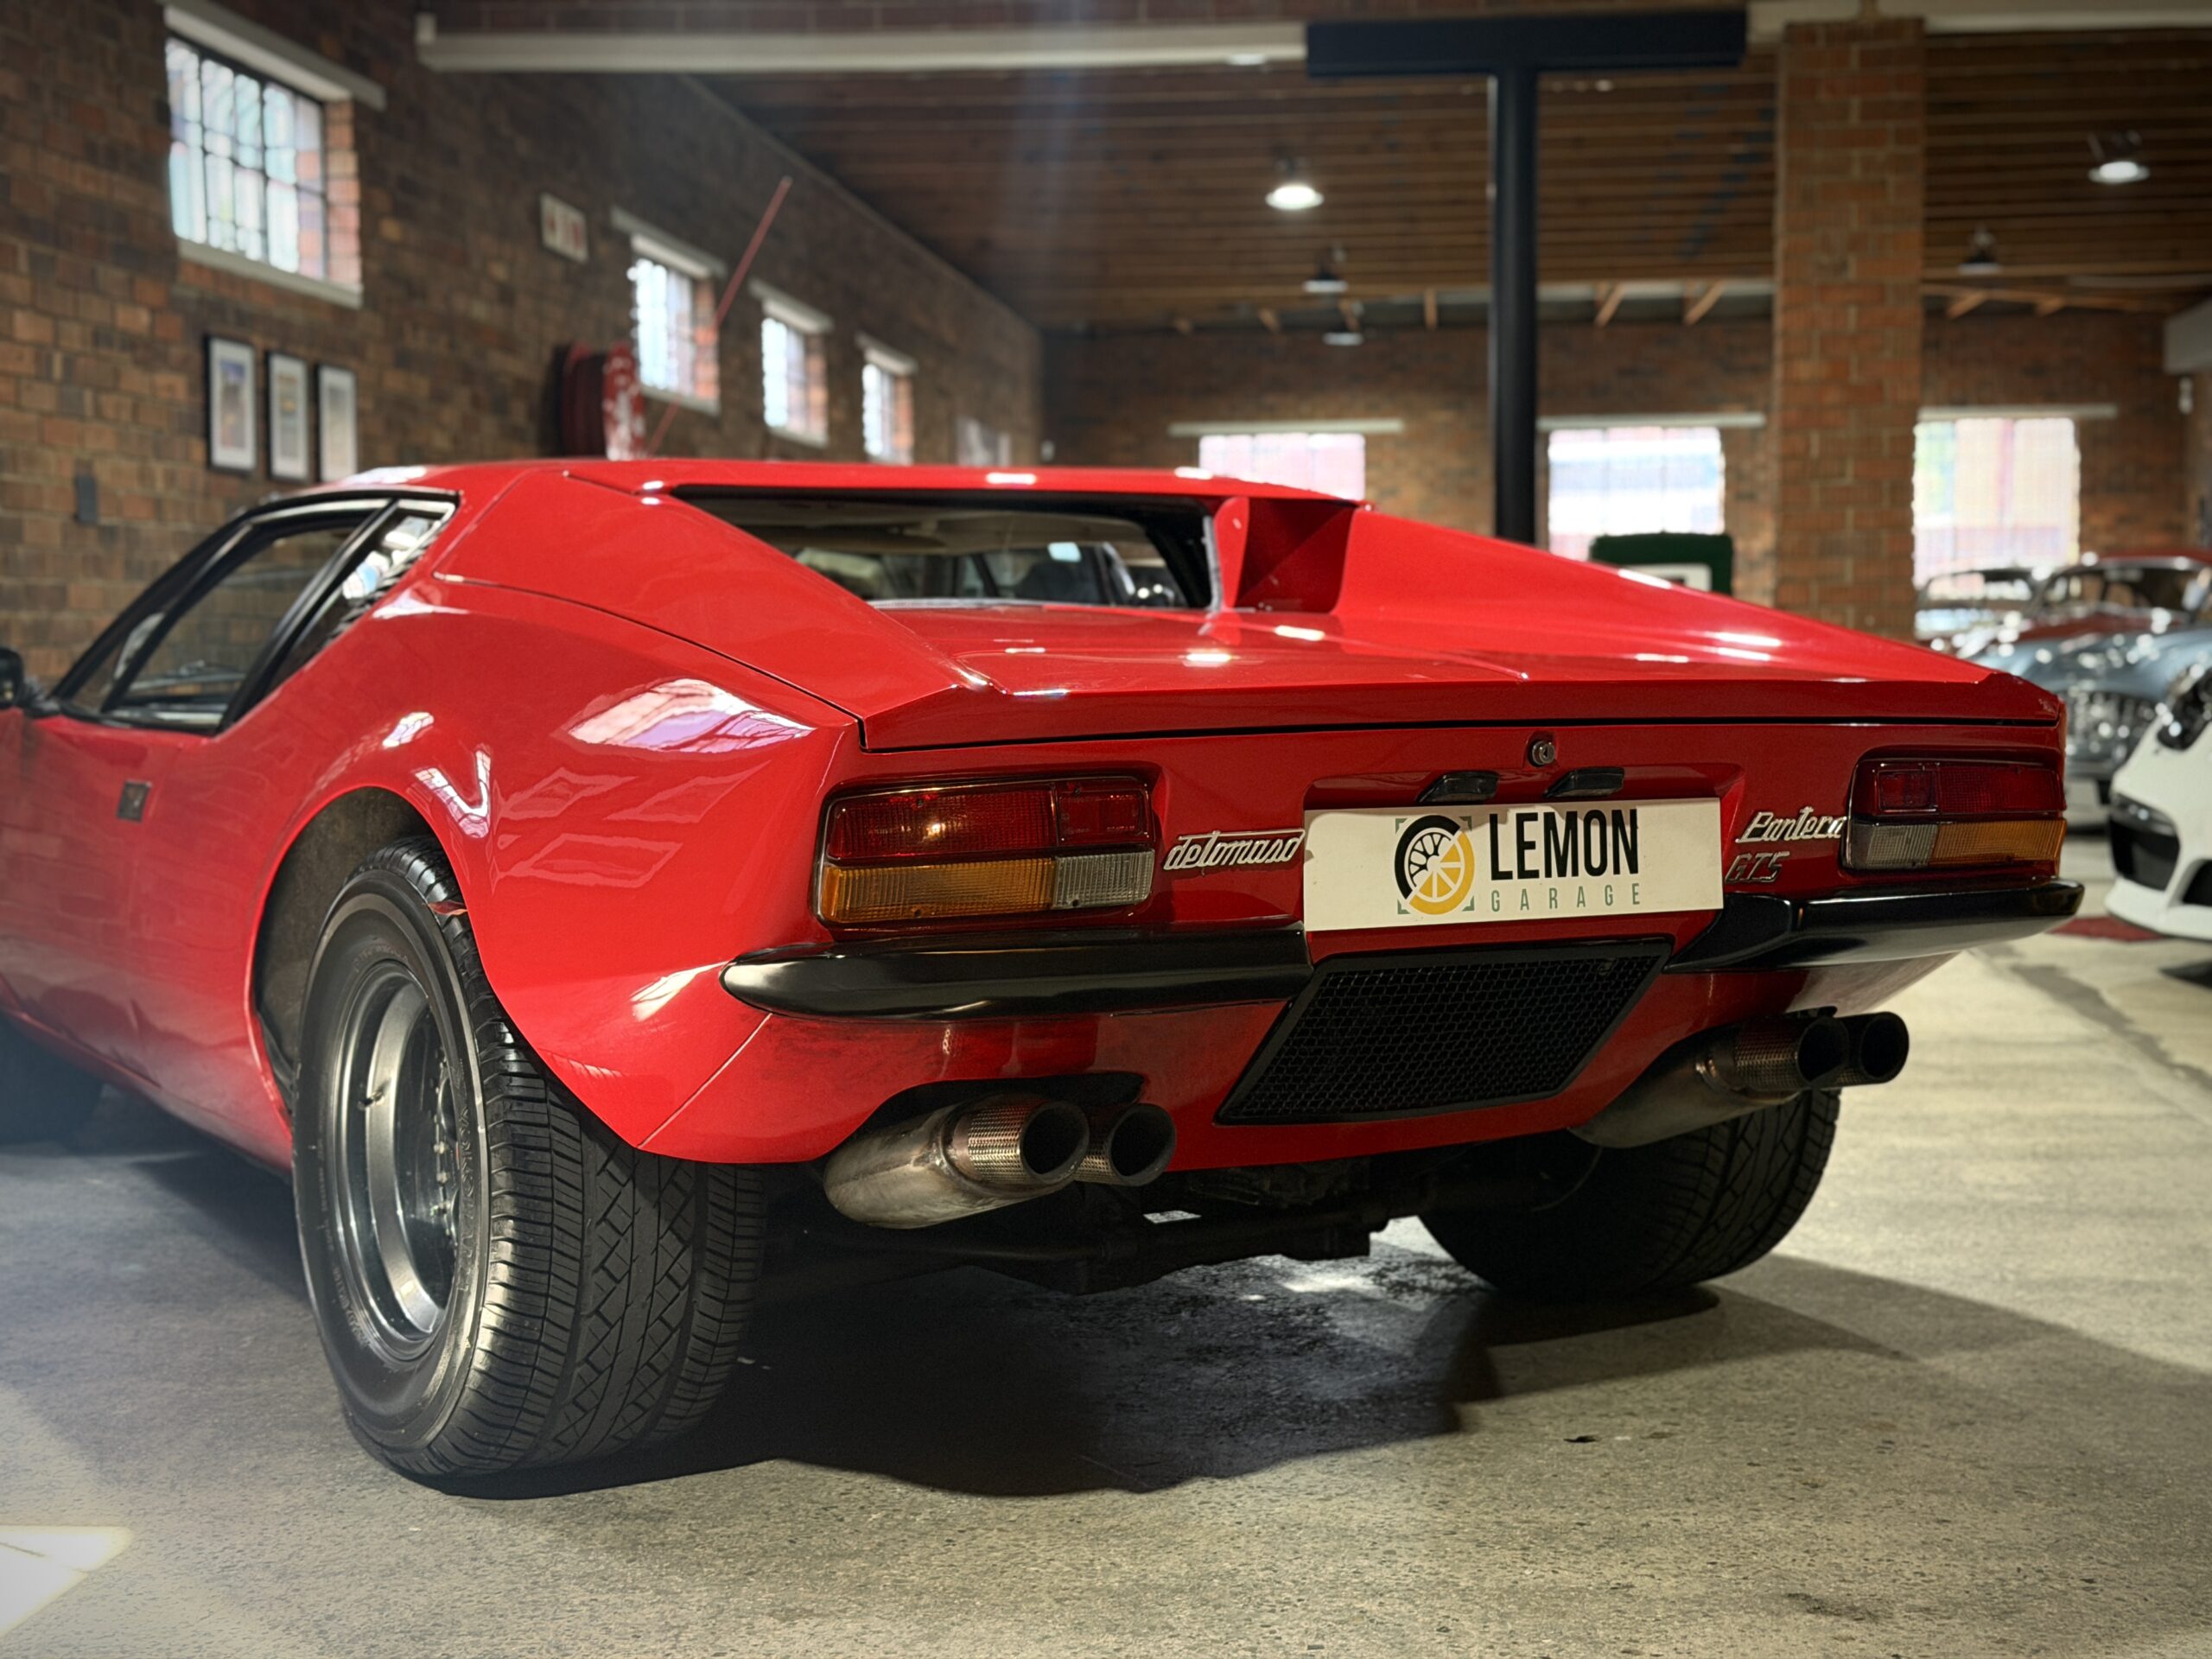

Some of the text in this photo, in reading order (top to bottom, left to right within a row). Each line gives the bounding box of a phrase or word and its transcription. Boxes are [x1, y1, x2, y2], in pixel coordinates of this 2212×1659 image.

[1735, 806, 1847, 842] Pantera
[1490, 809, 1638, 880] LEMON
[1725, 851, 1790, 884] GTS
[1491, 883, 1640, 912] GARAGE
